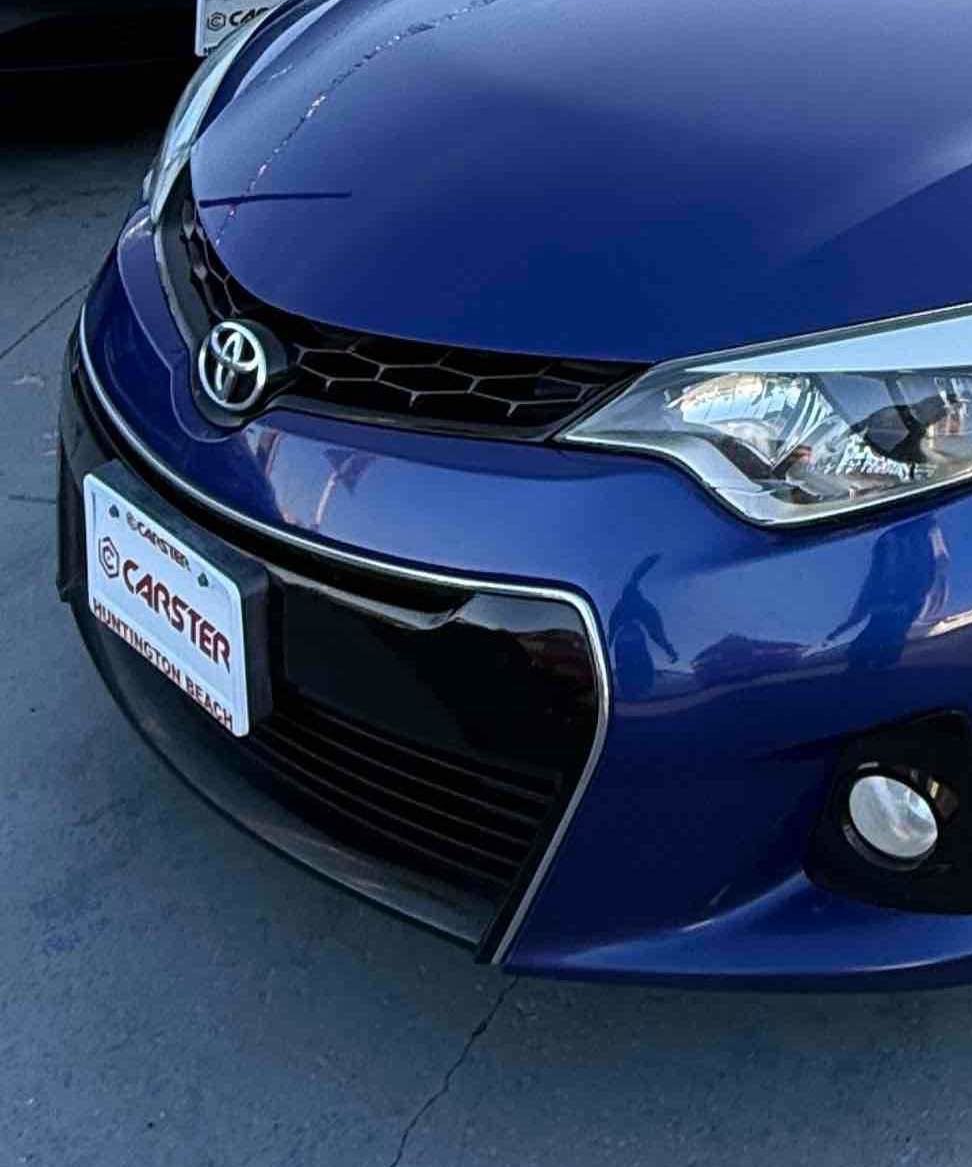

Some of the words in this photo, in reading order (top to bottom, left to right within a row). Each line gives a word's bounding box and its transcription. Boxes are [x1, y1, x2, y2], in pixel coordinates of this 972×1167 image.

[93, 598, 181, 685] HUNTINGTON
[186, 676, 233, 731] BEACH
[122, 559, 231, 674] CARSTER
